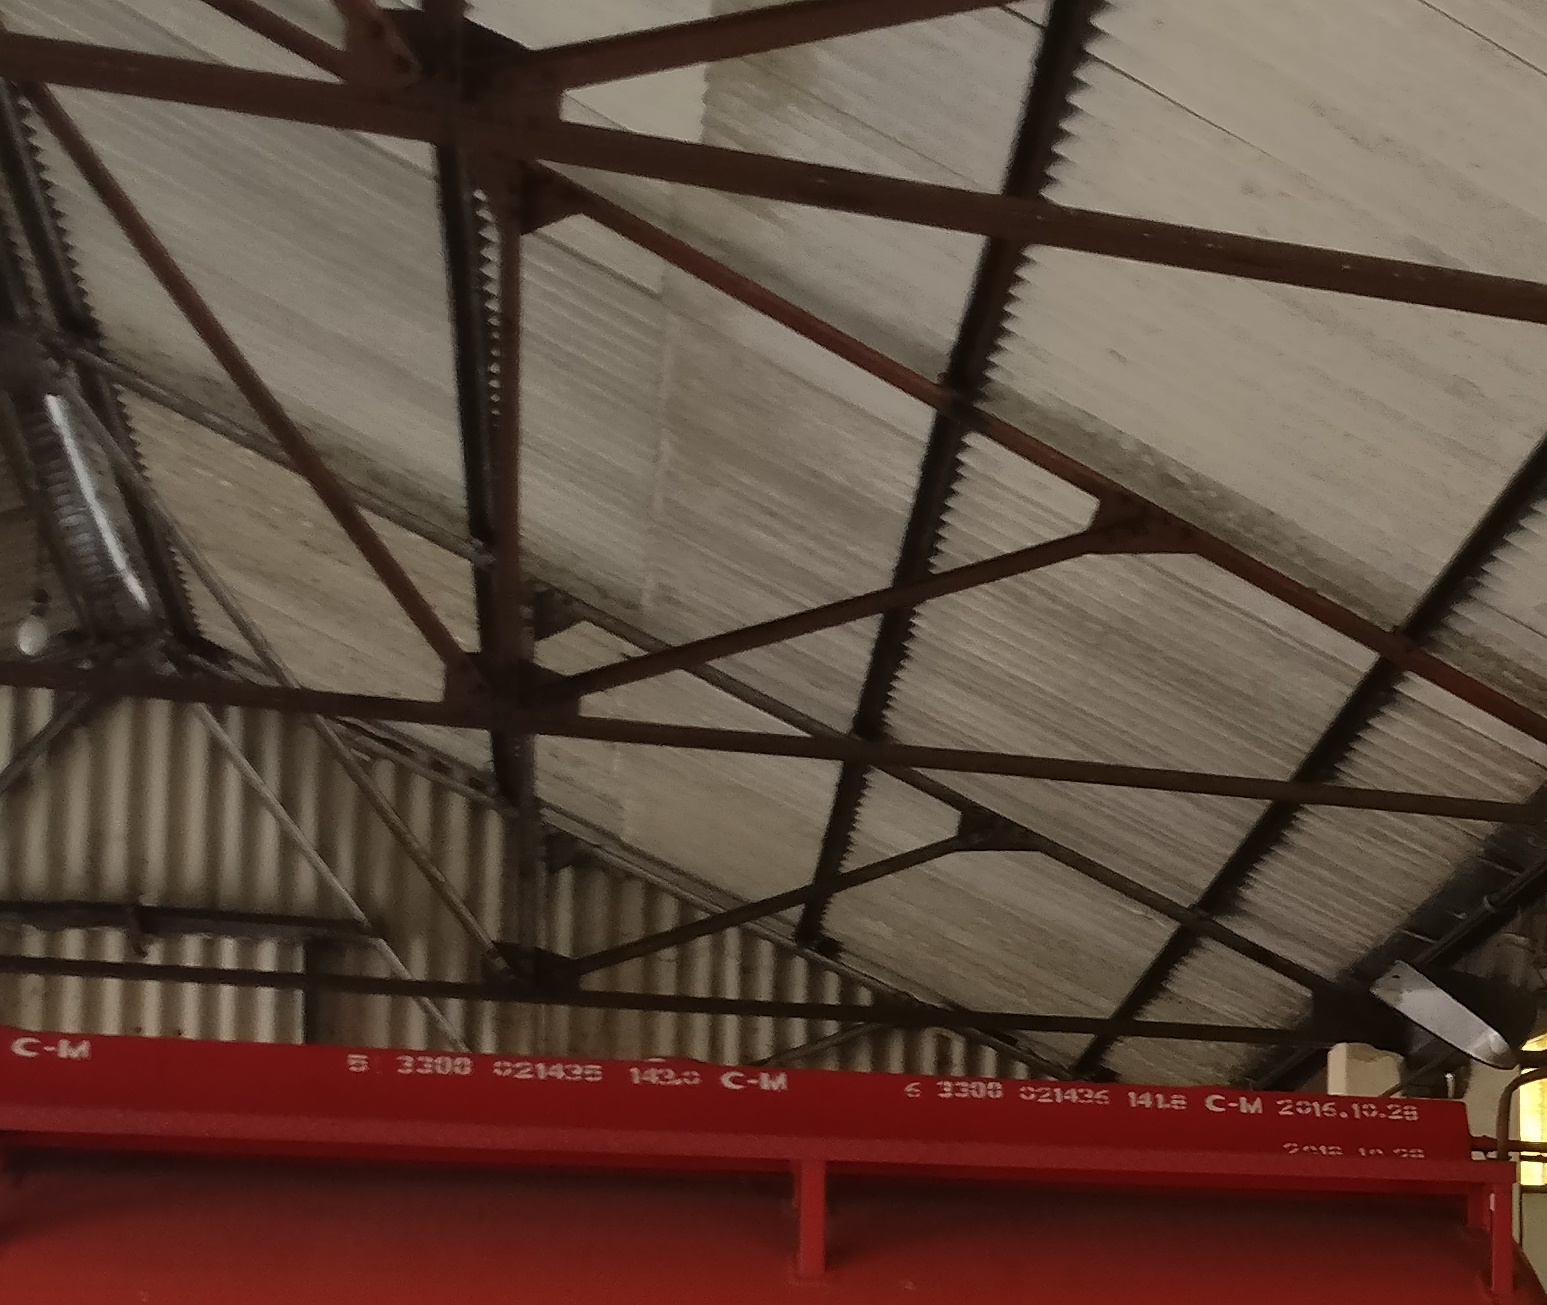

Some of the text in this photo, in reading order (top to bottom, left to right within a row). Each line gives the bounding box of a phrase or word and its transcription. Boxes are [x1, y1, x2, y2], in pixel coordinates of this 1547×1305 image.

[11, 1036, 91, 1060] C-M
[347, 1053, 369, 1074] 5
[720, 1071, 788, 1091] C-M
[1205, 1094, 1263, 1114] C-M
